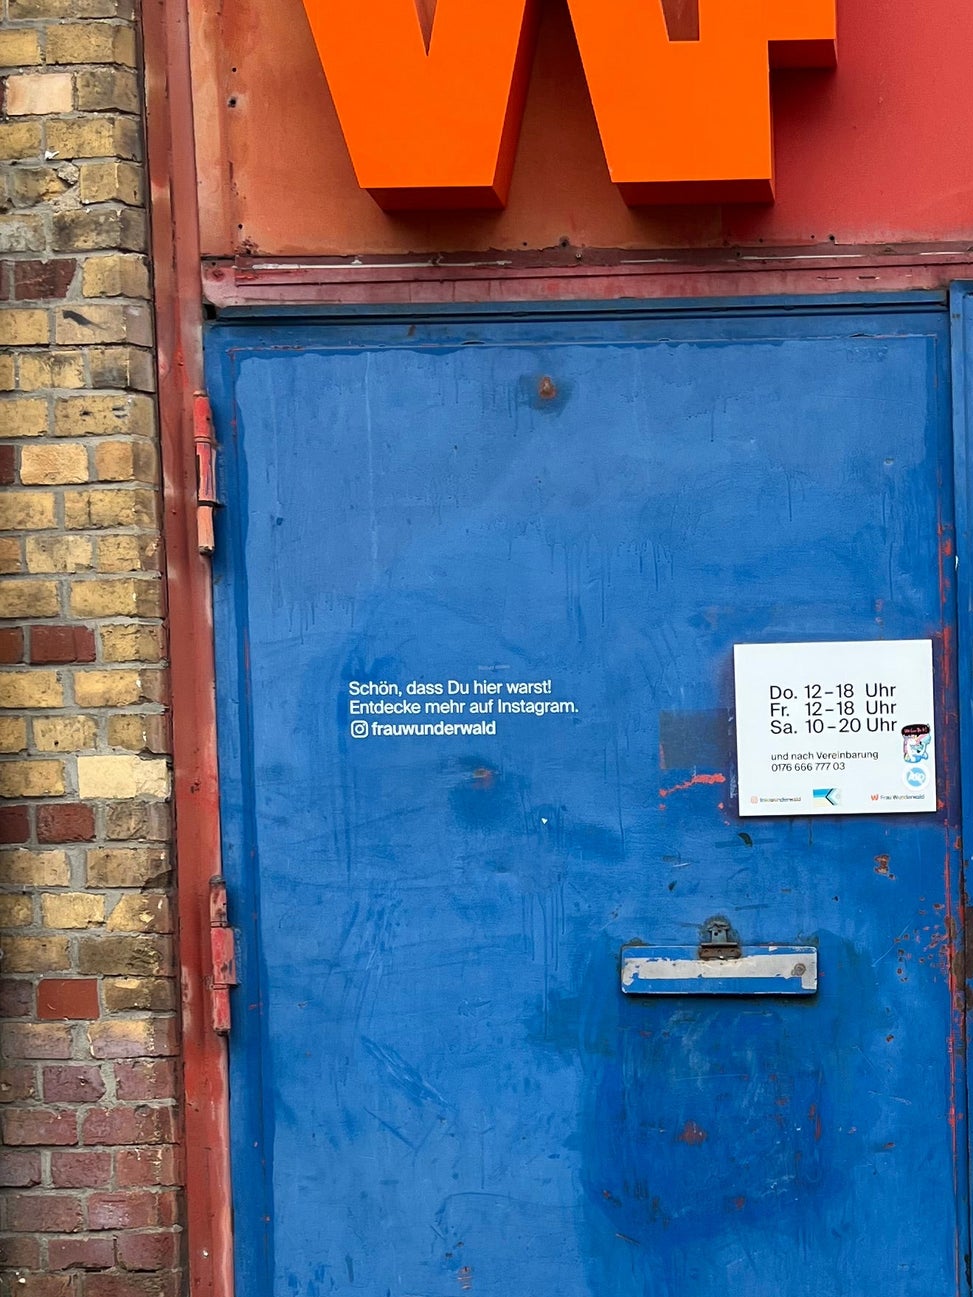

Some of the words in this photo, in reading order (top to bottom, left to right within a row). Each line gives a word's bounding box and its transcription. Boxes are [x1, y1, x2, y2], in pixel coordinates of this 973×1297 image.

[349, 680, 403, 697] Schön,
[406, 680, 444, 695] dass
[448, 680, 469, 695] Du
[473, 680, 502, 694] hier
[506, 680, 552, 694] warst!
[770, 685, 798, 700] Do.
[865, 682, 897, 698] Uhr
[349, 699, 422, 715] Entdecke
[425, 699, 465, 714] mehr
[469, 699, 494, 713] auf
[498, 699, 579, 716] Instagram.
[770, 702, 790, 717] Fr.
[866, 700, 897, 715] Uhr
[371, 720, 497, 736] frauwunderwald
[770, 719, 798, 734] Sa.
[866, 717, 898, 732] Uhr
[771, 752, 789, 761] und
[791, 752, 814, 761] nach
[816, 751, 879, 761] Vereinbarung
[771, 763, 792, 772] 0176
[794, 763, 813, 772] 666
[815, 762, 831, 771] 777
[832, 762, 846, 771] 03
